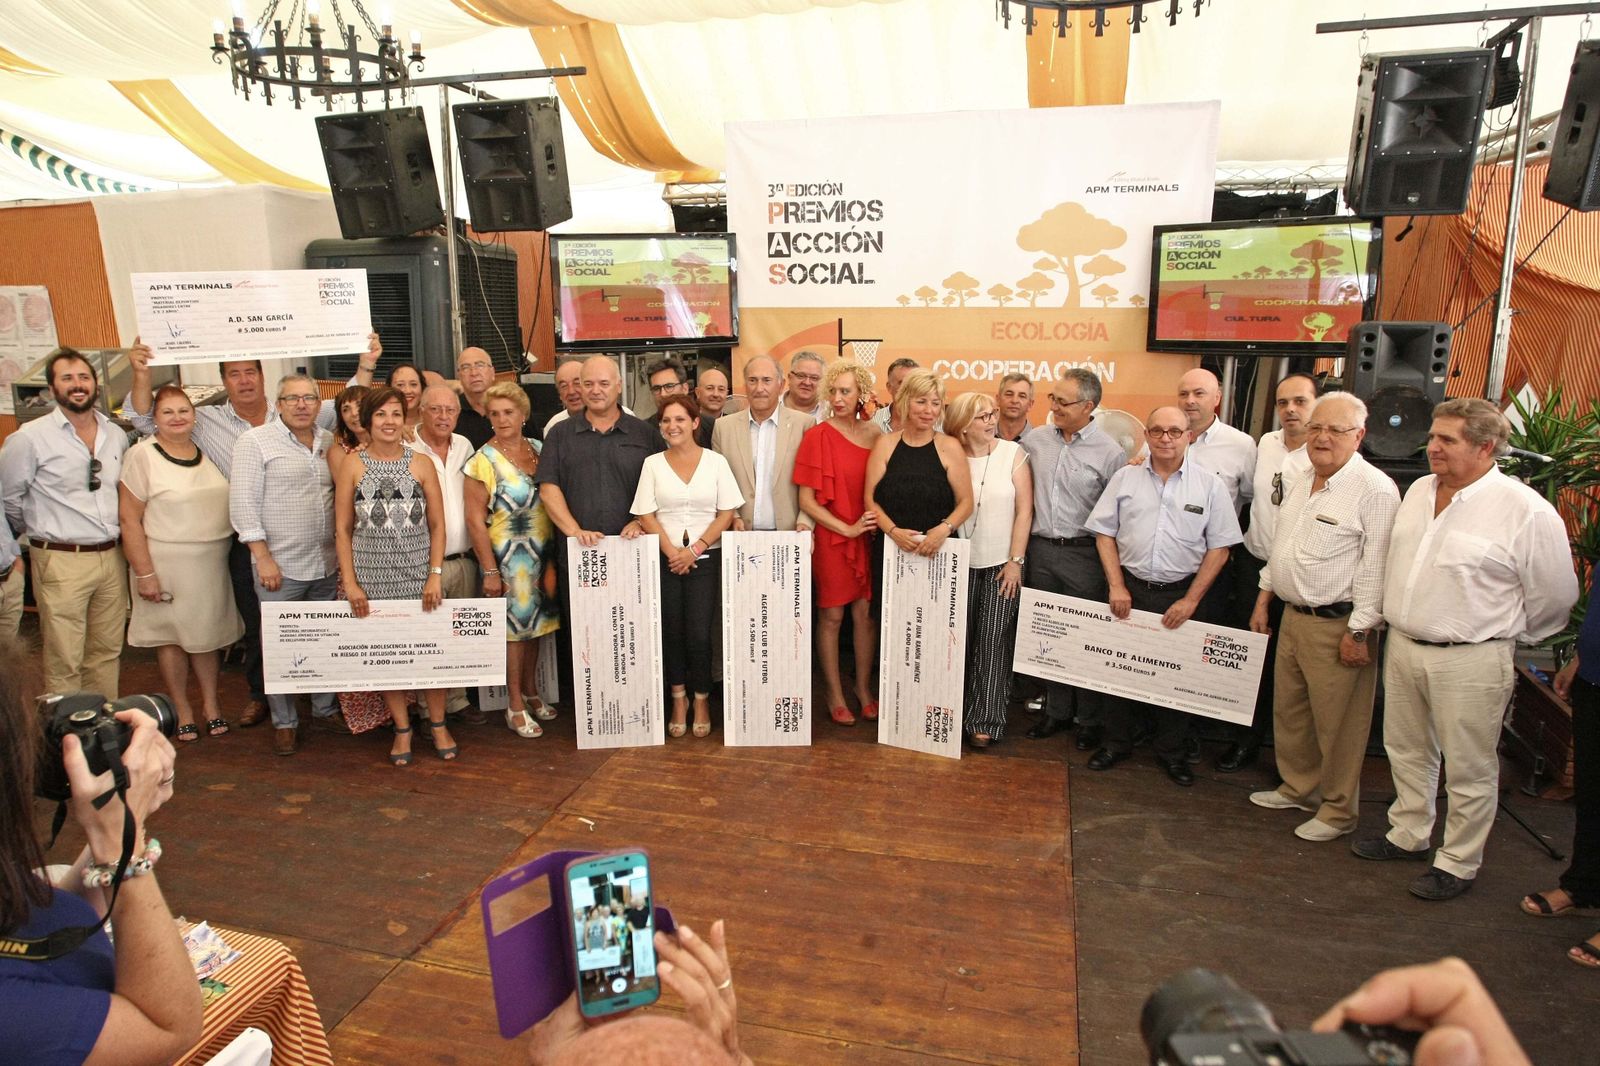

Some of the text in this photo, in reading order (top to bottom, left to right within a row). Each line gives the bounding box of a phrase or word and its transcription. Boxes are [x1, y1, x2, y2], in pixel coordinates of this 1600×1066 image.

[786, 180, 843, 197] EDICIÓN
[1113, 184, 1179, 193] TERMINALS
[768, 200, 883, 224] PREMIOS
[768, 225, 883, 258] ACCIÓN
[1168, 240, 1221, 249] PREMIOS
[565, 257, 614, 267] ACCIÓN
[1167, 249, 1221, 261] ACCIÓN
[768, 262, 875, 284] SOCIAL
[1167, 261, 1216, 270] SOCIAL
[991, 317, 1109, 341] ECOLOGÍA
[590, 550, 600, 587] ACCIÓN
[1034, 602, 1112, 622] APM TERMINALS
[453, 619, 492, 628] ACCIÓN
[1205, 638, 1248, 653] PREMIOS
[1085, 644, 1181, 671] BANCO DE ALIMENTOS
[1203, 646, 1248, 662] ACCIÓN
[1111, 661, 1132, 672] 3.560
[1133, 668, 1150, 676] EUROS
[1202, 655, 1242, 670] SOCIAL
[783, 697, 791, 732] ACCIÓN
[933, 706, 941, 742] ACCIÓN
